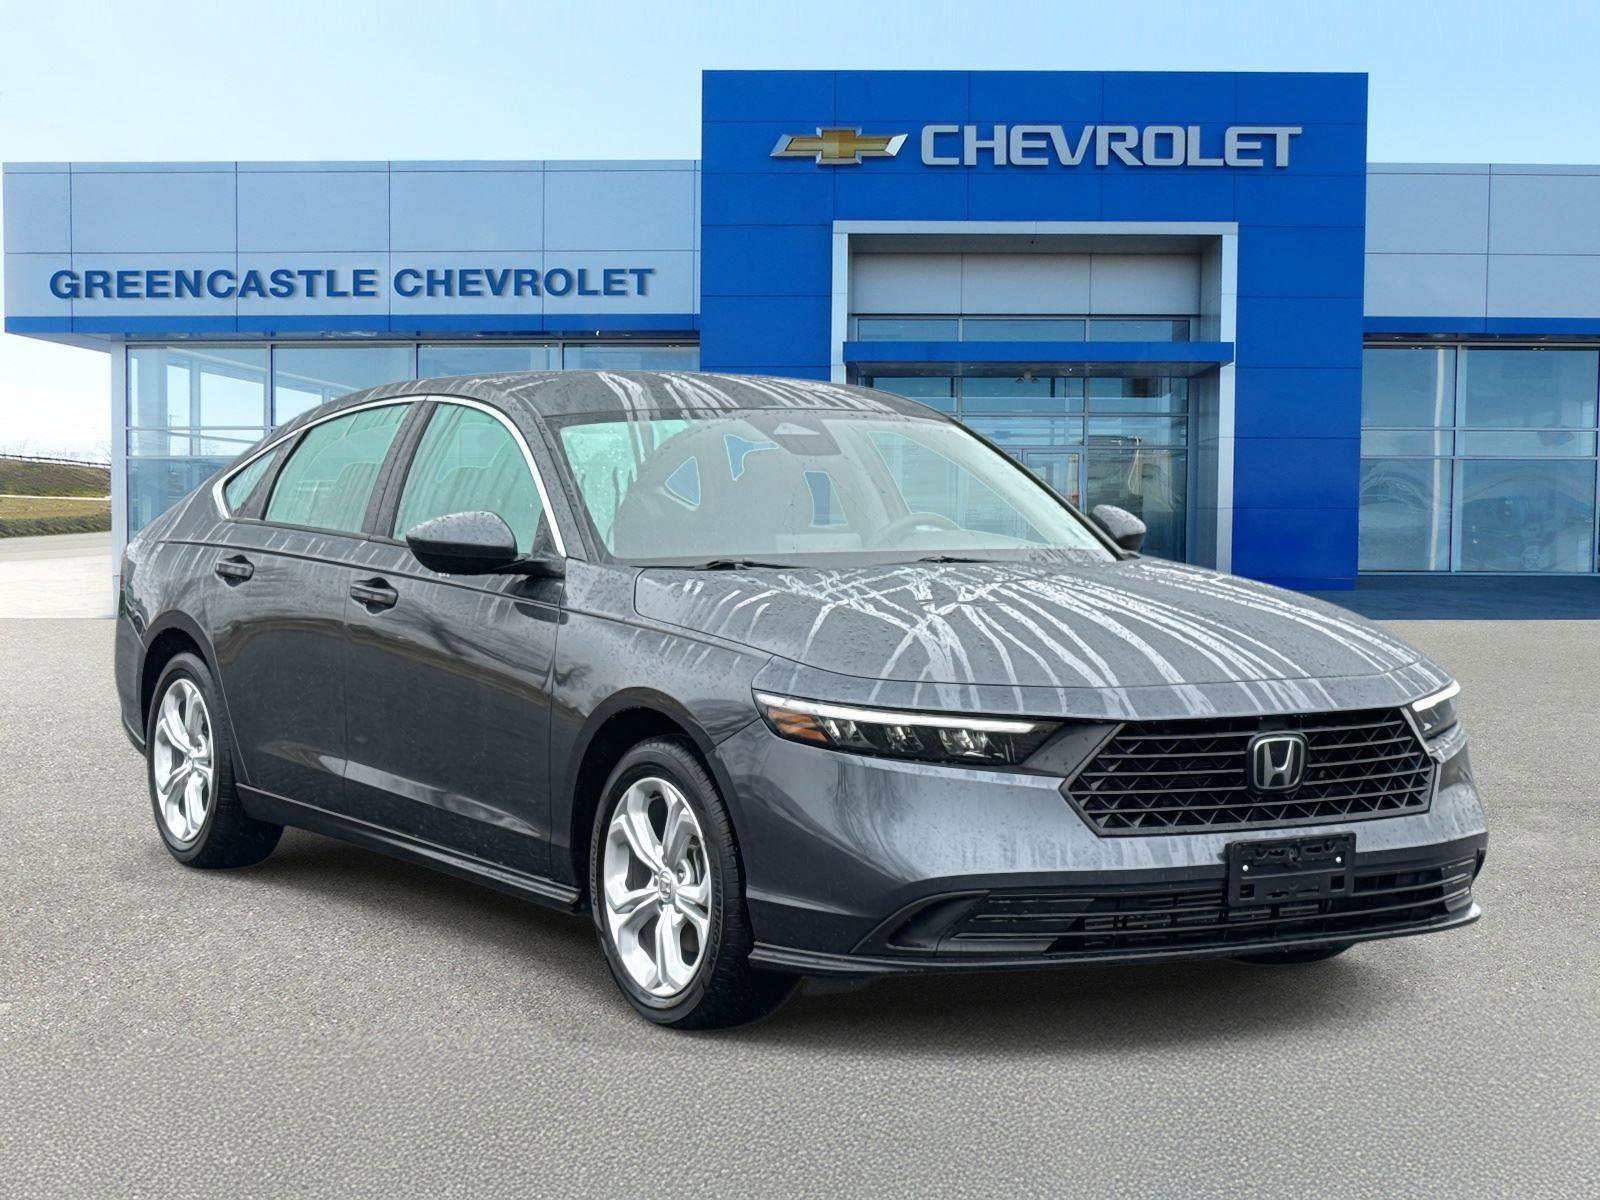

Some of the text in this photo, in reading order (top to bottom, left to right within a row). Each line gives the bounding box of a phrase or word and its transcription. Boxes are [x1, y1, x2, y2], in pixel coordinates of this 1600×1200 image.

[921, 125, 1303, 167] CHEVROLET
[50, 268, 655, 299] GREENCASTLE CHEVROLET
